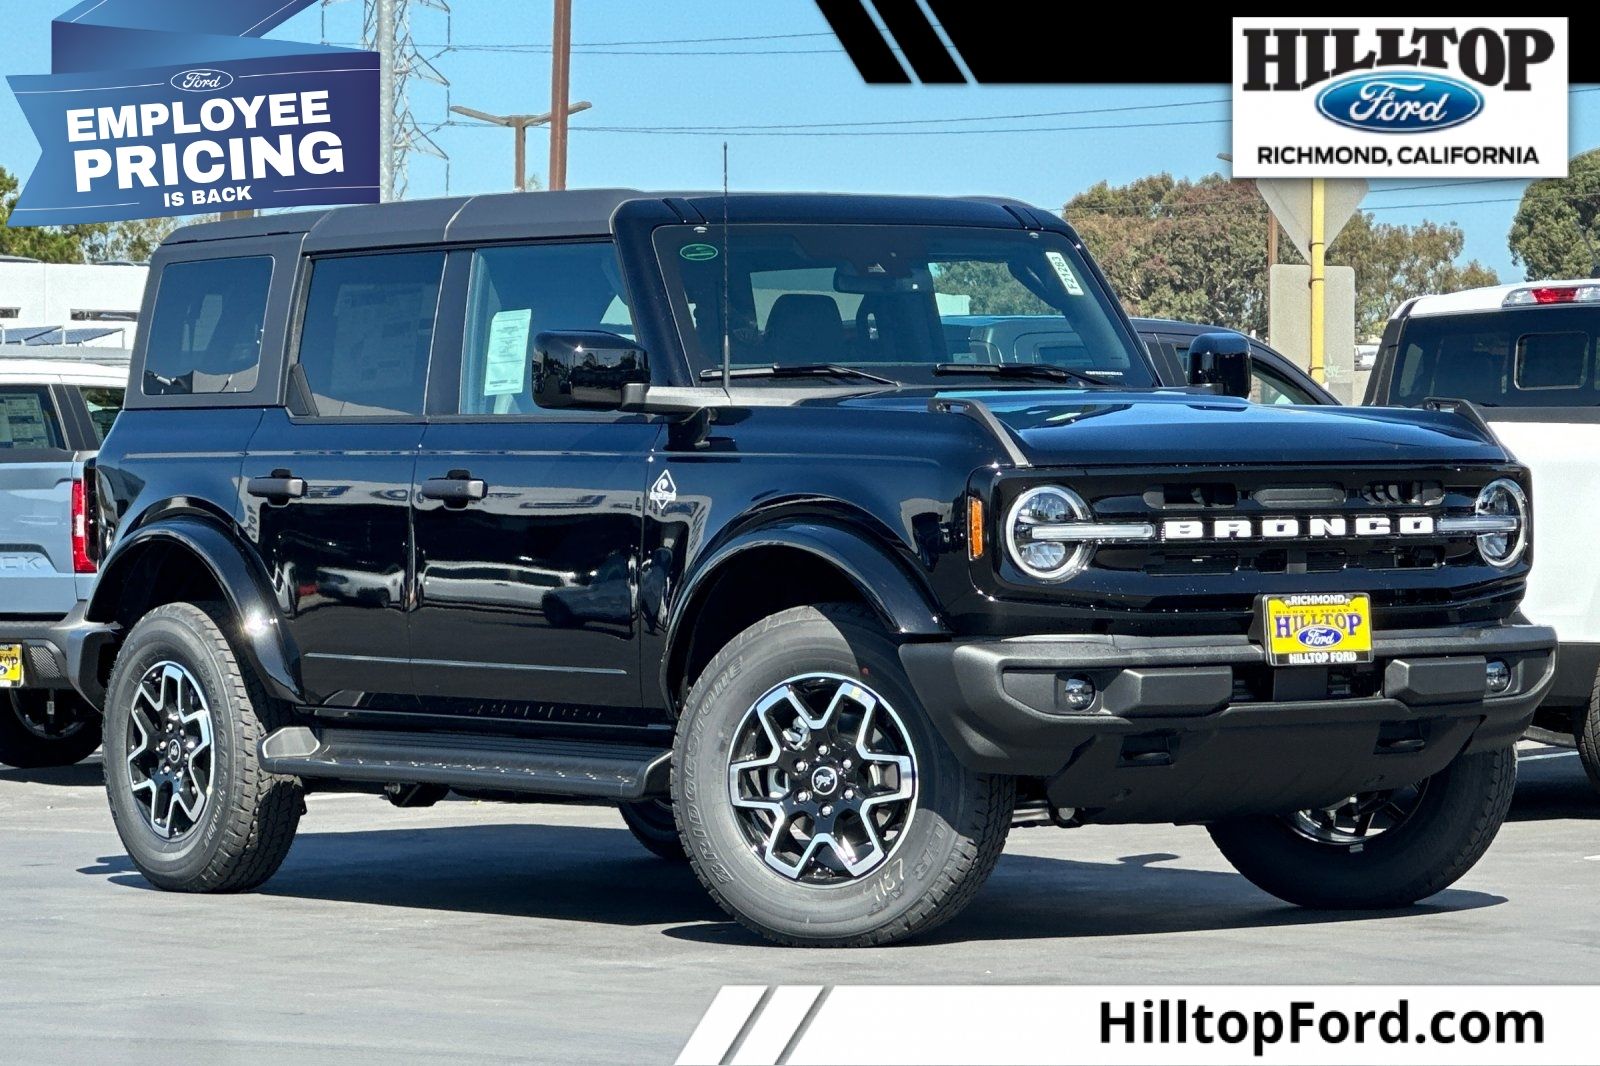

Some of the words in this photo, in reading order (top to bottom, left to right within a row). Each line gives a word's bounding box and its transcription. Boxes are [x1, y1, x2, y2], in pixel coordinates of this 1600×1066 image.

[1164, 516, 1434, 540] BRONCO
[1290, 594, 1345, 606] RICHMOND
[1274, 612, 1362, 638] HILLTOP
[1305, 629, 1335, 645] Ford
[1289, 652, 1329, 664] HILLTOP
[1330, 651, 1357, 663] FORD
